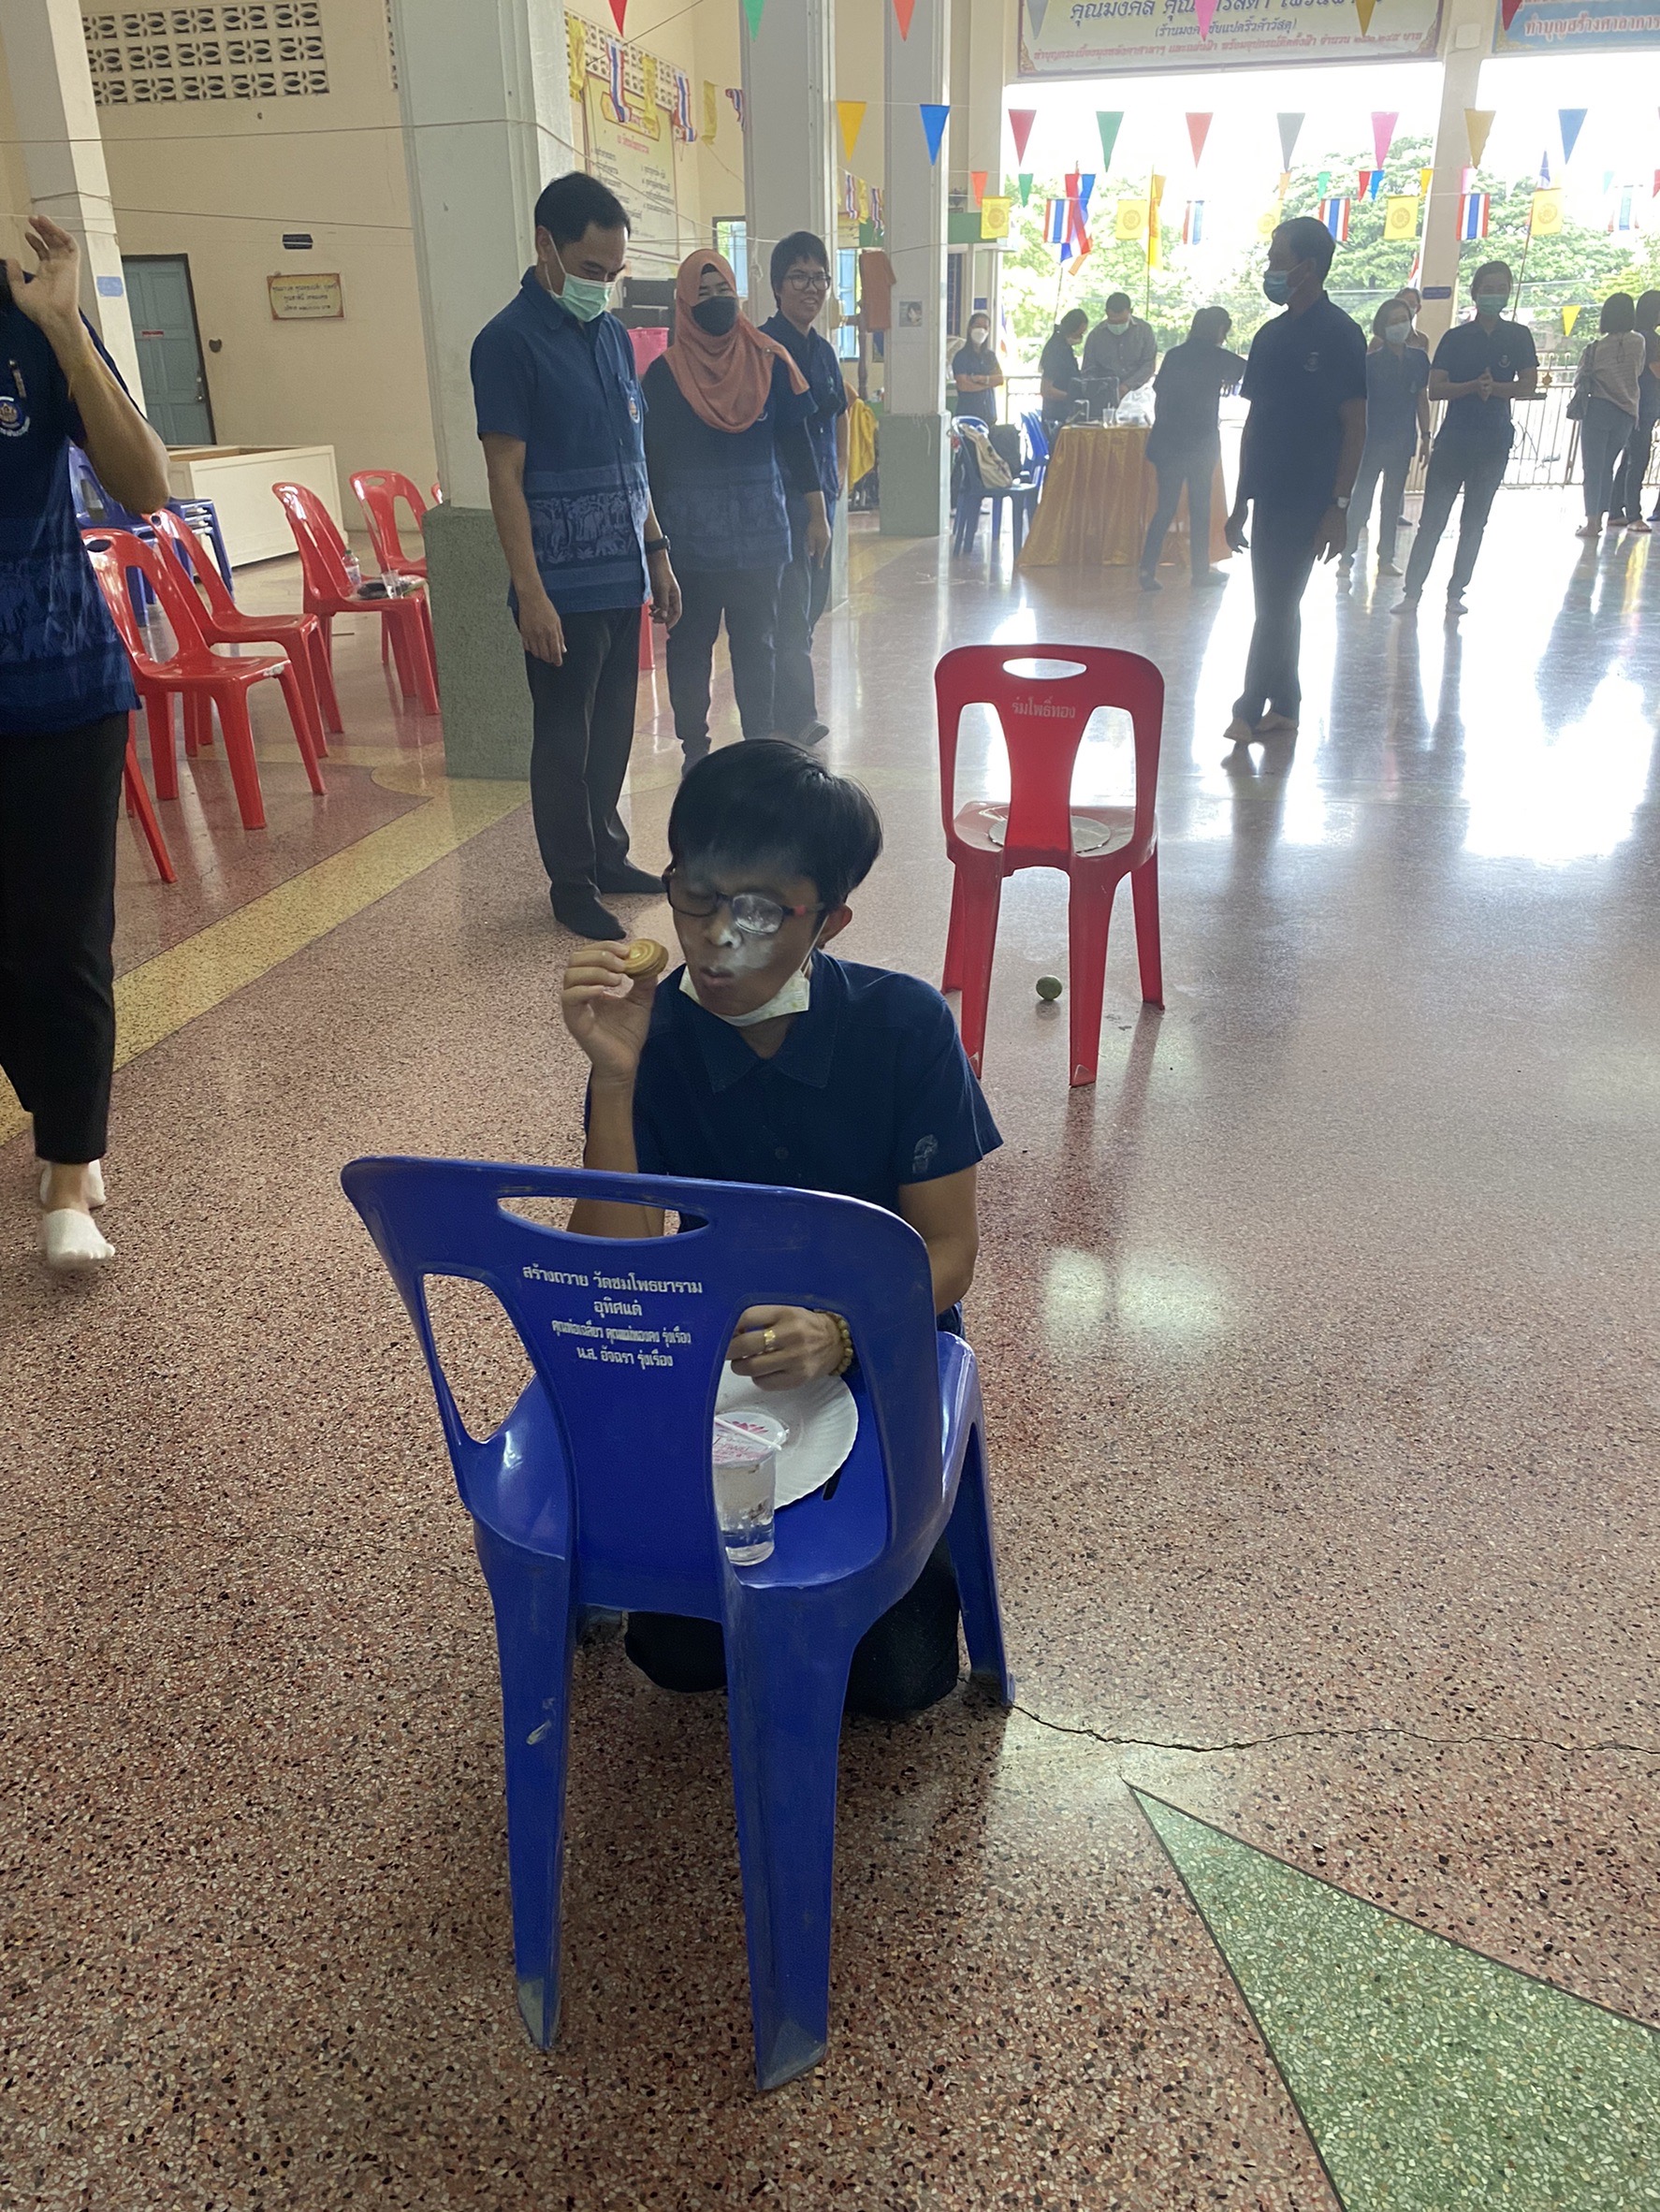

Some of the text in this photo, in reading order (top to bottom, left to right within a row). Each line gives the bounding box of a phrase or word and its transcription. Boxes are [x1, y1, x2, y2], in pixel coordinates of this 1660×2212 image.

[1070, 0, 1156, 26] คุณมงคล
[1012, 695, 1076, 719] ร่มโพธิ์ทอง
[522, 1263, 703, 1293] สร้างถวาย วัดชมโพธยาราม
[593, 1297, 643, 1318] อุทิศแด่
[600, 1345, 634, 1364] อัจฉรา
[637, 1348, 674, 1370] รุ่งเรือง
